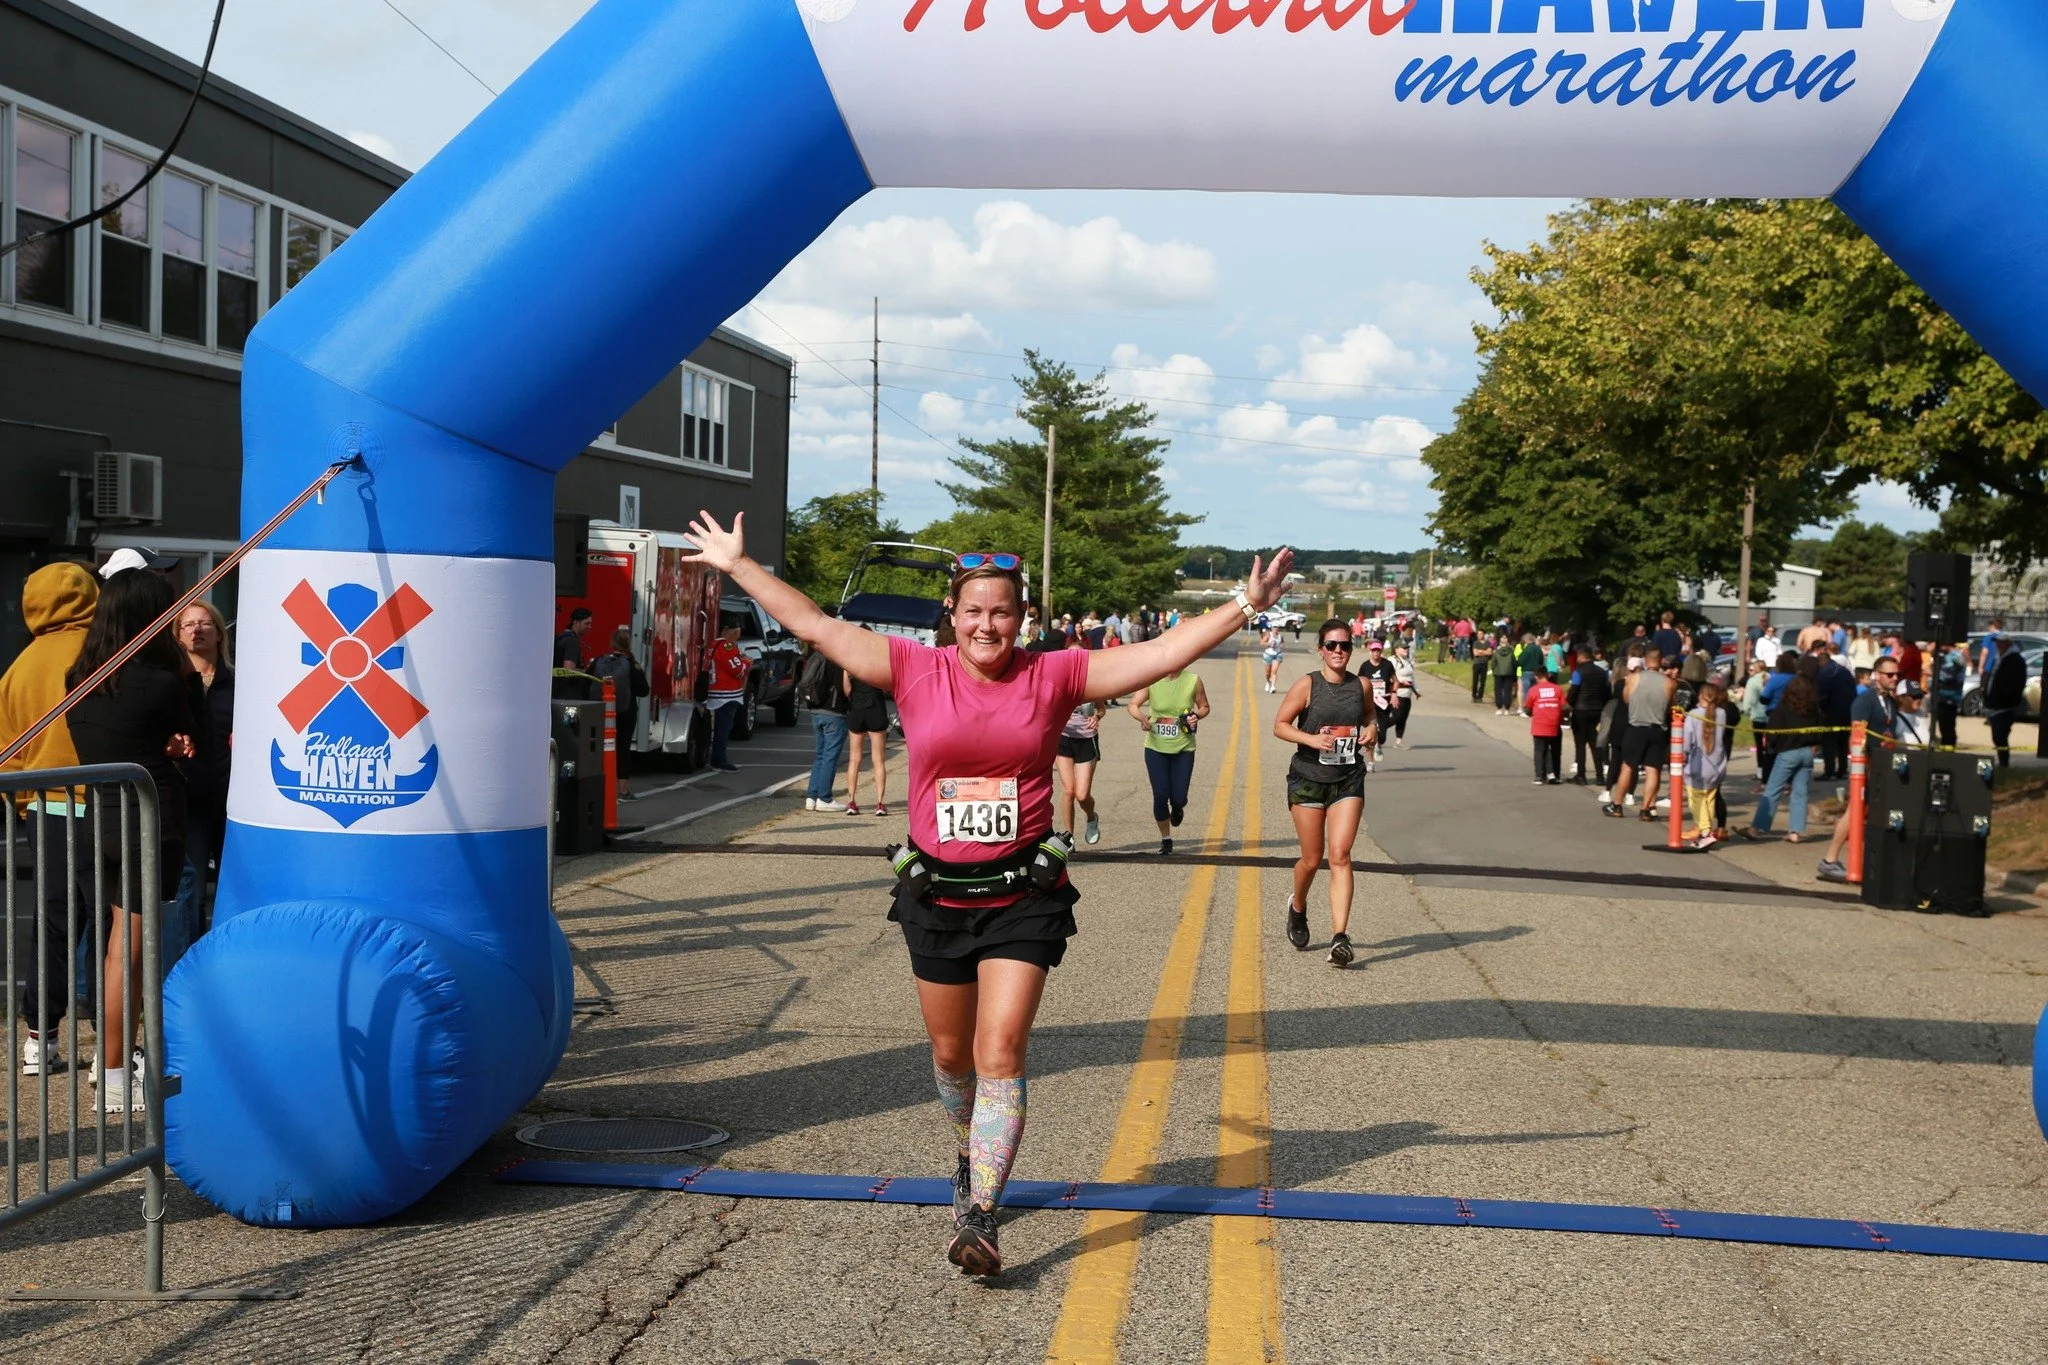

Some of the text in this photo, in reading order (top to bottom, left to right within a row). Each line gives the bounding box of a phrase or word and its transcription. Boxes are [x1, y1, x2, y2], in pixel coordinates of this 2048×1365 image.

[1394, 29, 1857, 107] marathon
[728, 656, 742, 669] 19
[1156, 725, 1177, 737] 1398
[307, 732, 388, 758] Holland
[1325, 738, 1354, 754] 174
[301, 754, 396, 789] HAVEN
[300, 791, 394, 804] MARATHON
[945, 804, 1011, 836] 1436
